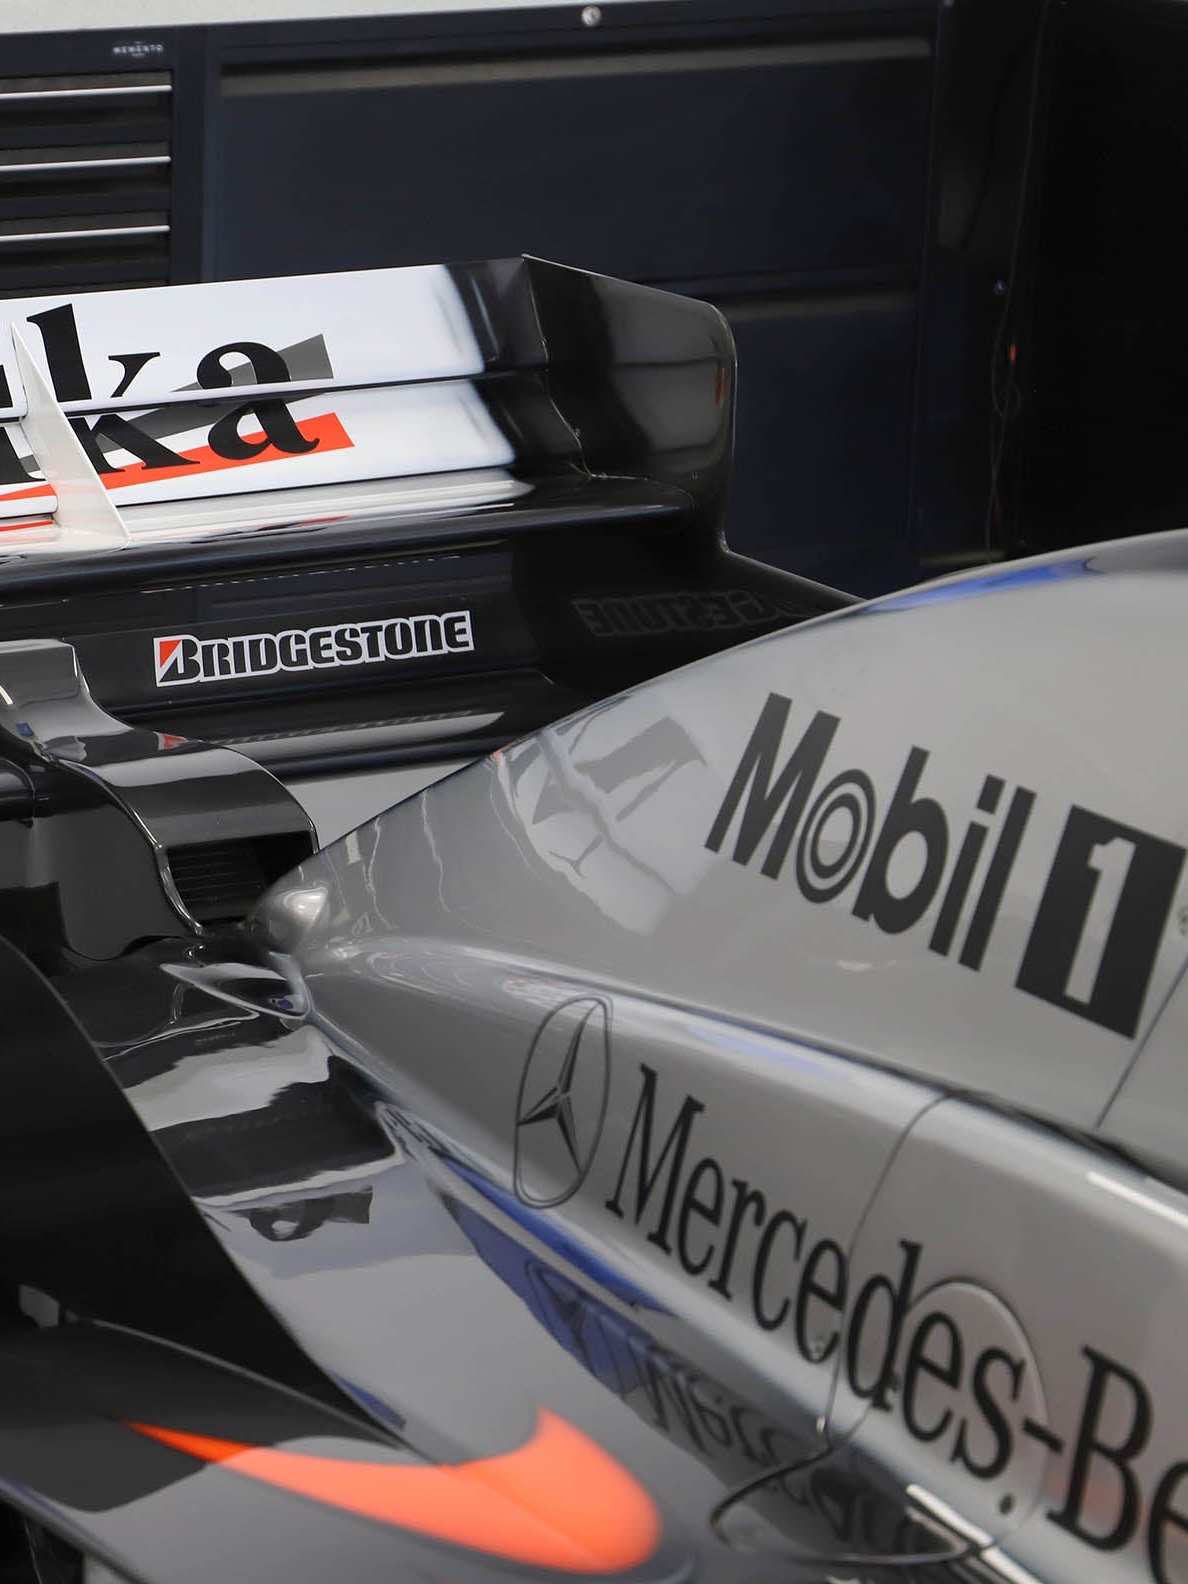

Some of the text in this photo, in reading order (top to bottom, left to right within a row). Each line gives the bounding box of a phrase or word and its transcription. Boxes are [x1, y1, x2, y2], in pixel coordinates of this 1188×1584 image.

[153, 611, 475, 688] BRIDGESTONE
[704, 691, 1137, 1005] Mobil 1
